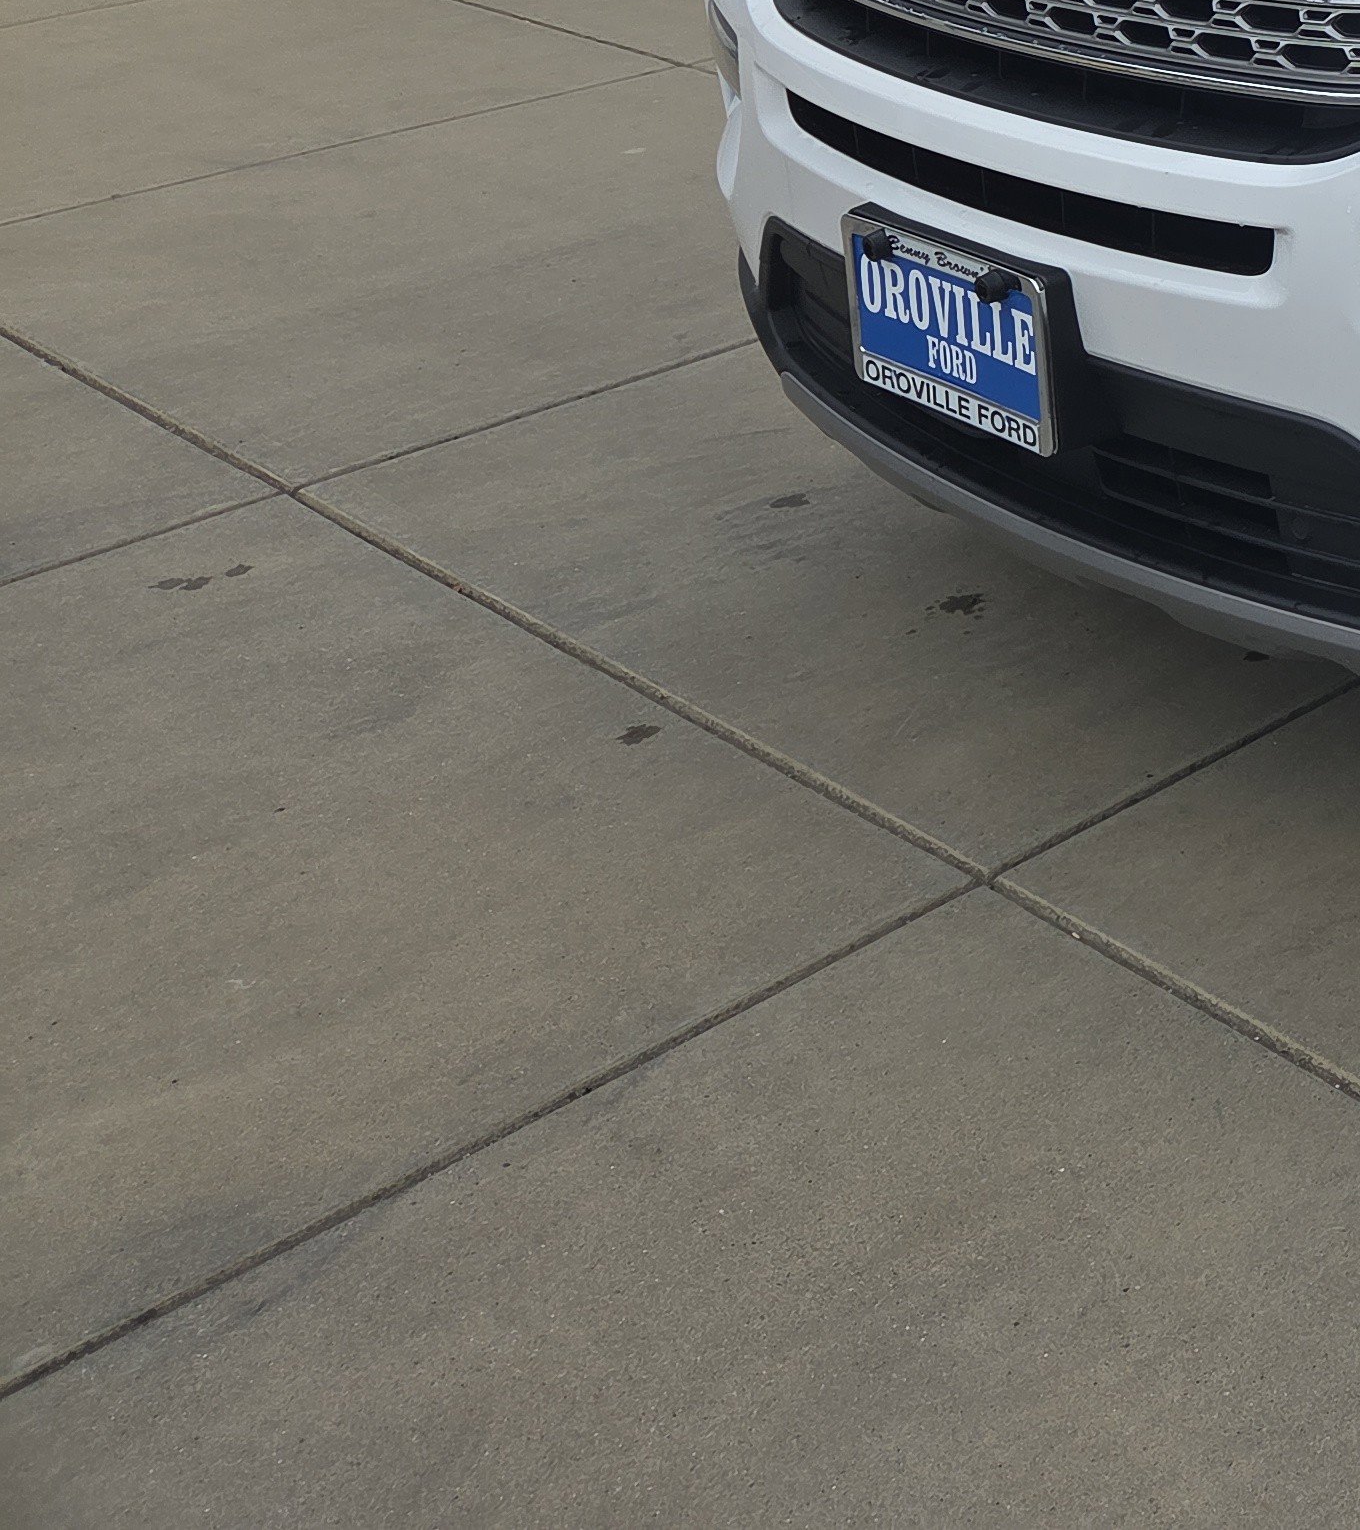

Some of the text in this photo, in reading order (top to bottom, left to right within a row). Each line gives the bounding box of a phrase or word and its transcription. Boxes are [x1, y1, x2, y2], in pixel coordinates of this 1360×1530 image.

[887, 234, 931, 266] Benny
[860, 253, 1037, 376] OROVILLE
[926, 334, 977, 385] FORD
[865, 359, 1037, 448] OROVILLE FORD
